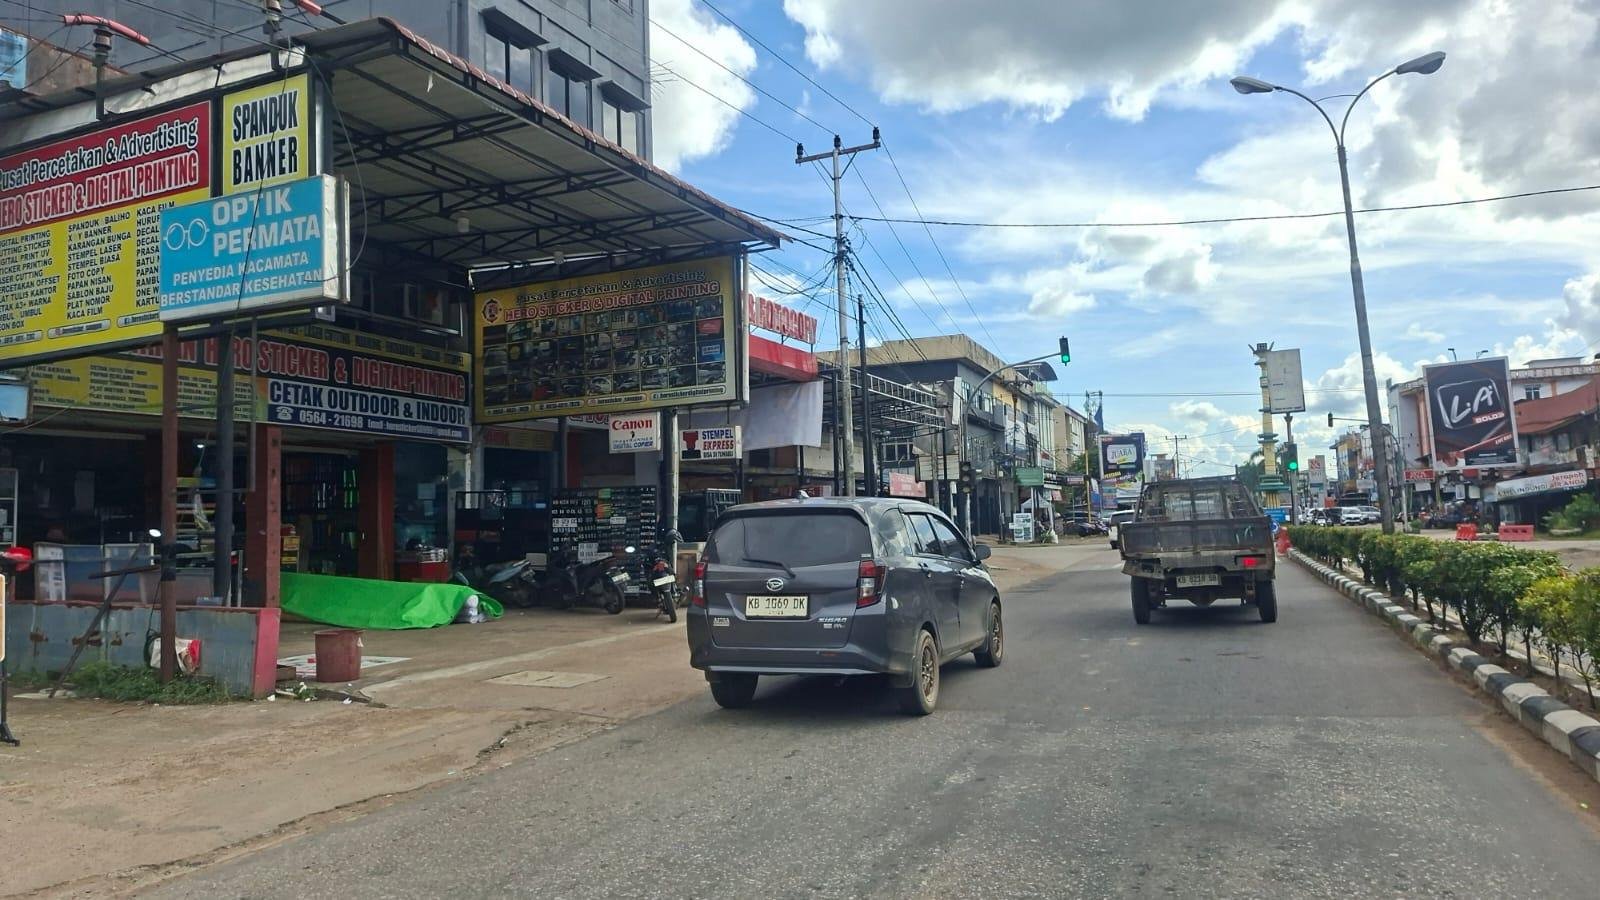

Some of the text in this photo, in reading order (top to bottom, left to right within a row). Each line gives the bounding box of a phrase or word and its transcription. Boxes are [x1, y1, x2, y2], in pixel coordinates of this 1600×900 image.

[233, 90, 298, 142] SPANDUK
[31, 146, 102, 185] Percetakan
[105, 138, 118, 165] &
[119, 117, 198, 161] Advertising
[233, 137, 298, 185] BANNER
[25, 183, 73, 225] STICKER
[74, 185, 86, 214] &
[86, 165, 134, 208] DIGITAL
[135, 150, 199, 200] PRINTING
[137, 206, 156, 217] KACA
[213, 187, 292, 225] OPTIK
[68, 212, 131, 233] SPANDUK BALIHO
[21, 230, 51, 244] PRINTING
[84, 226, 112, 239] BANNER
[213, 215, 321, 256] PERMATA
[24, 240, 51, 252] STICKER
[68, 232, 131, 252] KARANGAN BUNGA
[21, 252, 39, 263] PRINT
[68, 243, 122, 262] STEMPEL LASER
[23, 259, 53, 271] PRINTING
[68, 254, 120, 272] STEMPEL BIASA
[137, 256, 155, 267] BATU
[173, 252, 308, 286] PENYEDIA KACAMATA
[16, 270, 43, 282] CUTTING
[37, 275, 60, 287] OFFSET
[68, 266, 105, 281] FOTO COPY
[68, 275, 111, 291] PAPAN NISAN
[160, 270, 322, 307] BERSTANDAR KESEHATAN
[552, 283, 619, 304] Percetakan
[622, 280, 635, 293] &
[635, 270, 707, 292] Advertising
[31, 286, 57, 298] KANTOR
[67, 285, 114, 302] SABLON BAJU
[136, 287, 150, 298] ONE
[67, 296, 111, 311] PLAT NOMOR
[505, 281, 721, 322] HERO STICKER & DIGITAL PRINTING
[67, 306, 103, 321] KACA FILM
[258, 340, 329, 381] STICKER
[334, 355, 349, 384] &
[270, 379, 324, 408] CETAK
[327, 388, 400, 418] OUTDOOR
[403, 401, 413, 419] &
[416, 401, 465, 427] INDOOR
[299, 409, 327, 425] 0564
[612, 419, 653, 431] Canon
[702, 430, 734, 440] STEMPEL
[702, 439, 734, 451] EXPRESS
[747, 598, 760, 609] KB
[793, 597, 806, 609] DK
